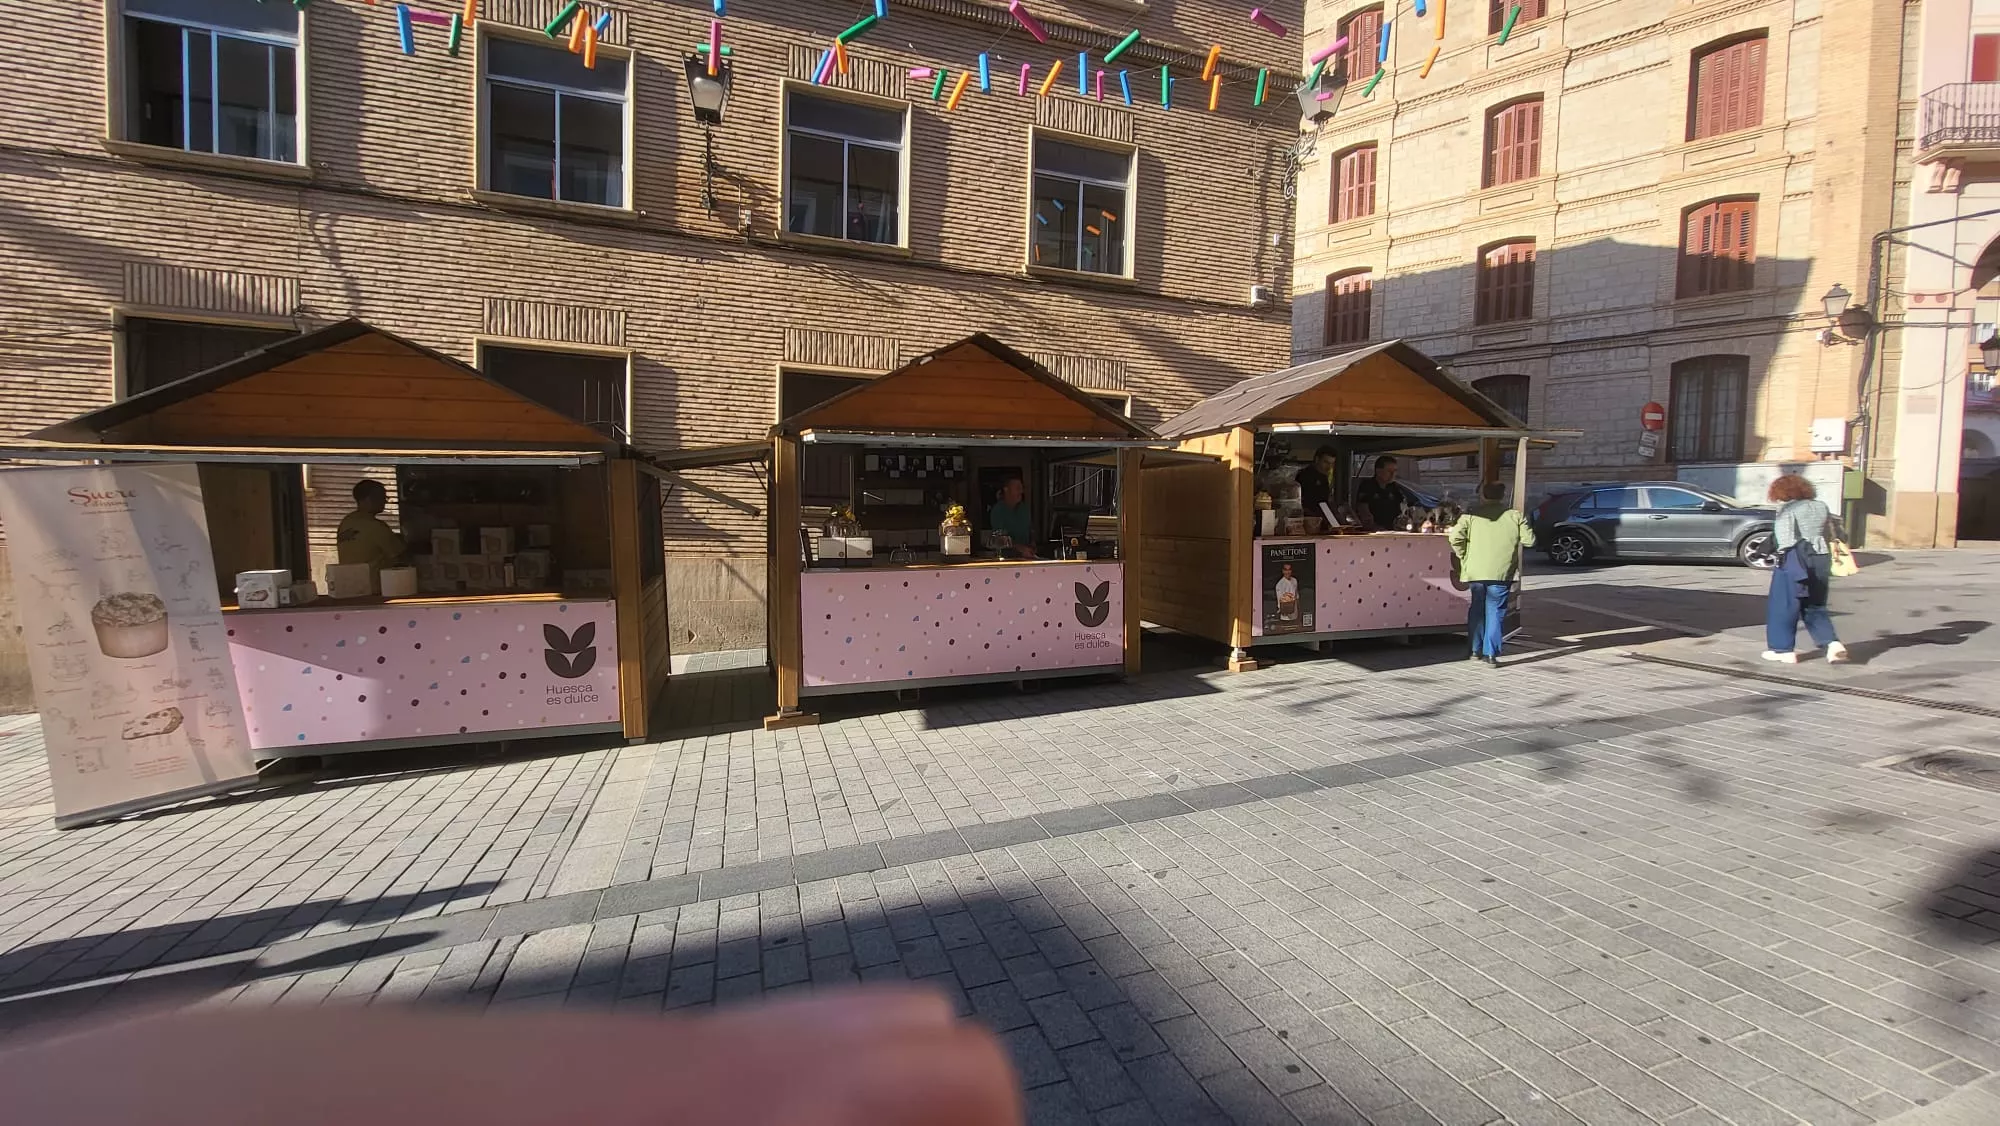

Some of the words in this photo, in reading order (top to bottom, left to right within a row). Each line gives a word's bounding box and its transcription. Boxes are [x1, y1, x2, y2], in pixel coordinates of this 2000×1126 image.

[1270, 548, 1308, 556] PANETTONE
[1074, 632, 1106, 640] Huesca
[1086, 640, 1110, 648] dulce
[546, 684, 593, 694] Huesca
[546, 697, 562, 705] es
[564, 694, 598, 704] dulce
